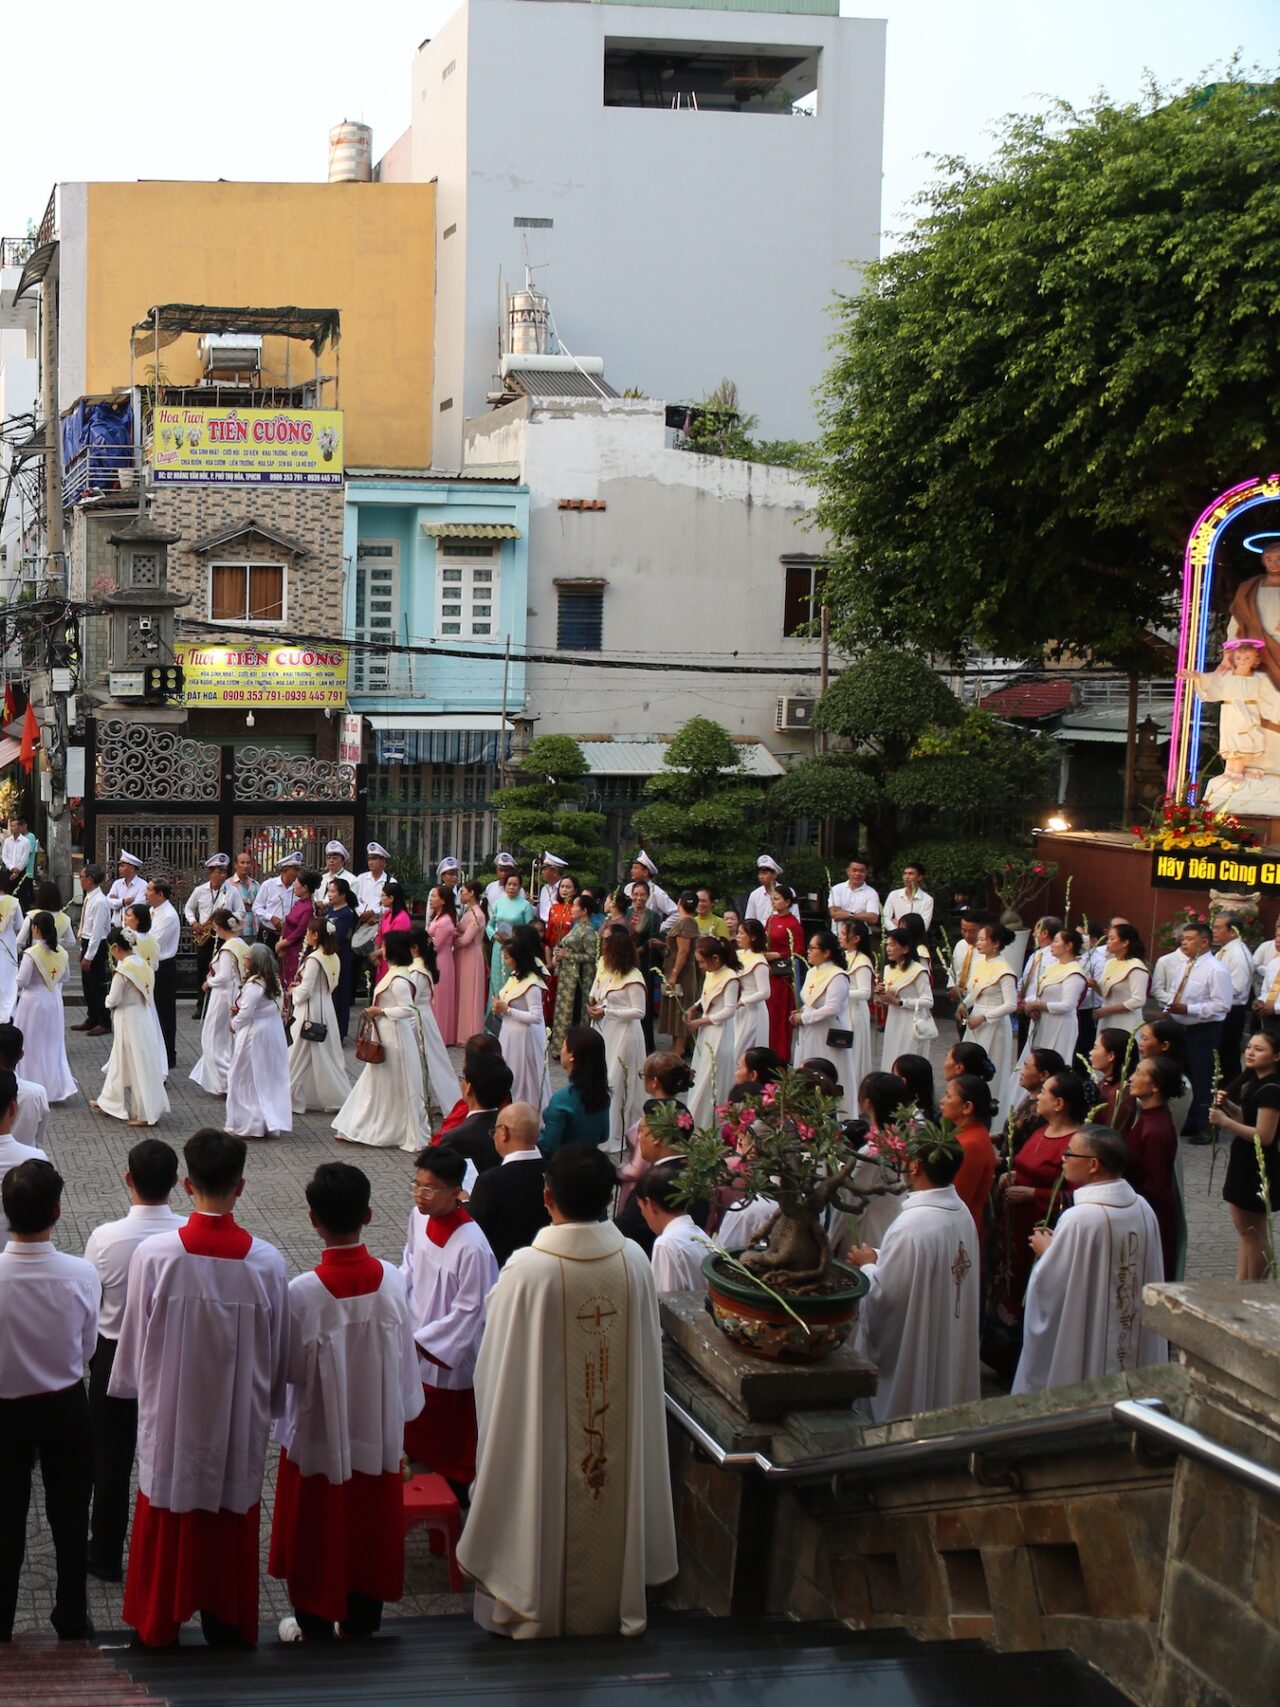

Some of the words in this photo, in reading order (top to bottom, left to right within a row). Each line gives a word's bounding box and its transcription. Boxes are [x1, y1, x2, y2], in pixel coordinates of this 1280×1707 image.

[159, 410, 179, 423] Hoa
[208, 410, 249, 442] TIẾN
[253, 415, 314, 443] CƯỜNG
[225, 646, 269, 666] TIẾN
[275, 647, 343, 667] CƯỜNG
[203, 692, 217, 700] HOA
[223, 690, 245, 701] 0909
[247, 690, 263, 701] 353
[309, 691, 325, 701] 445
[328, 691, 343, 701] 791
[1157, 856, 1185, 880] Hãy
[1188, 856, 1216, 879] Đến
[1219, 860, 1257, 886] Cùng
